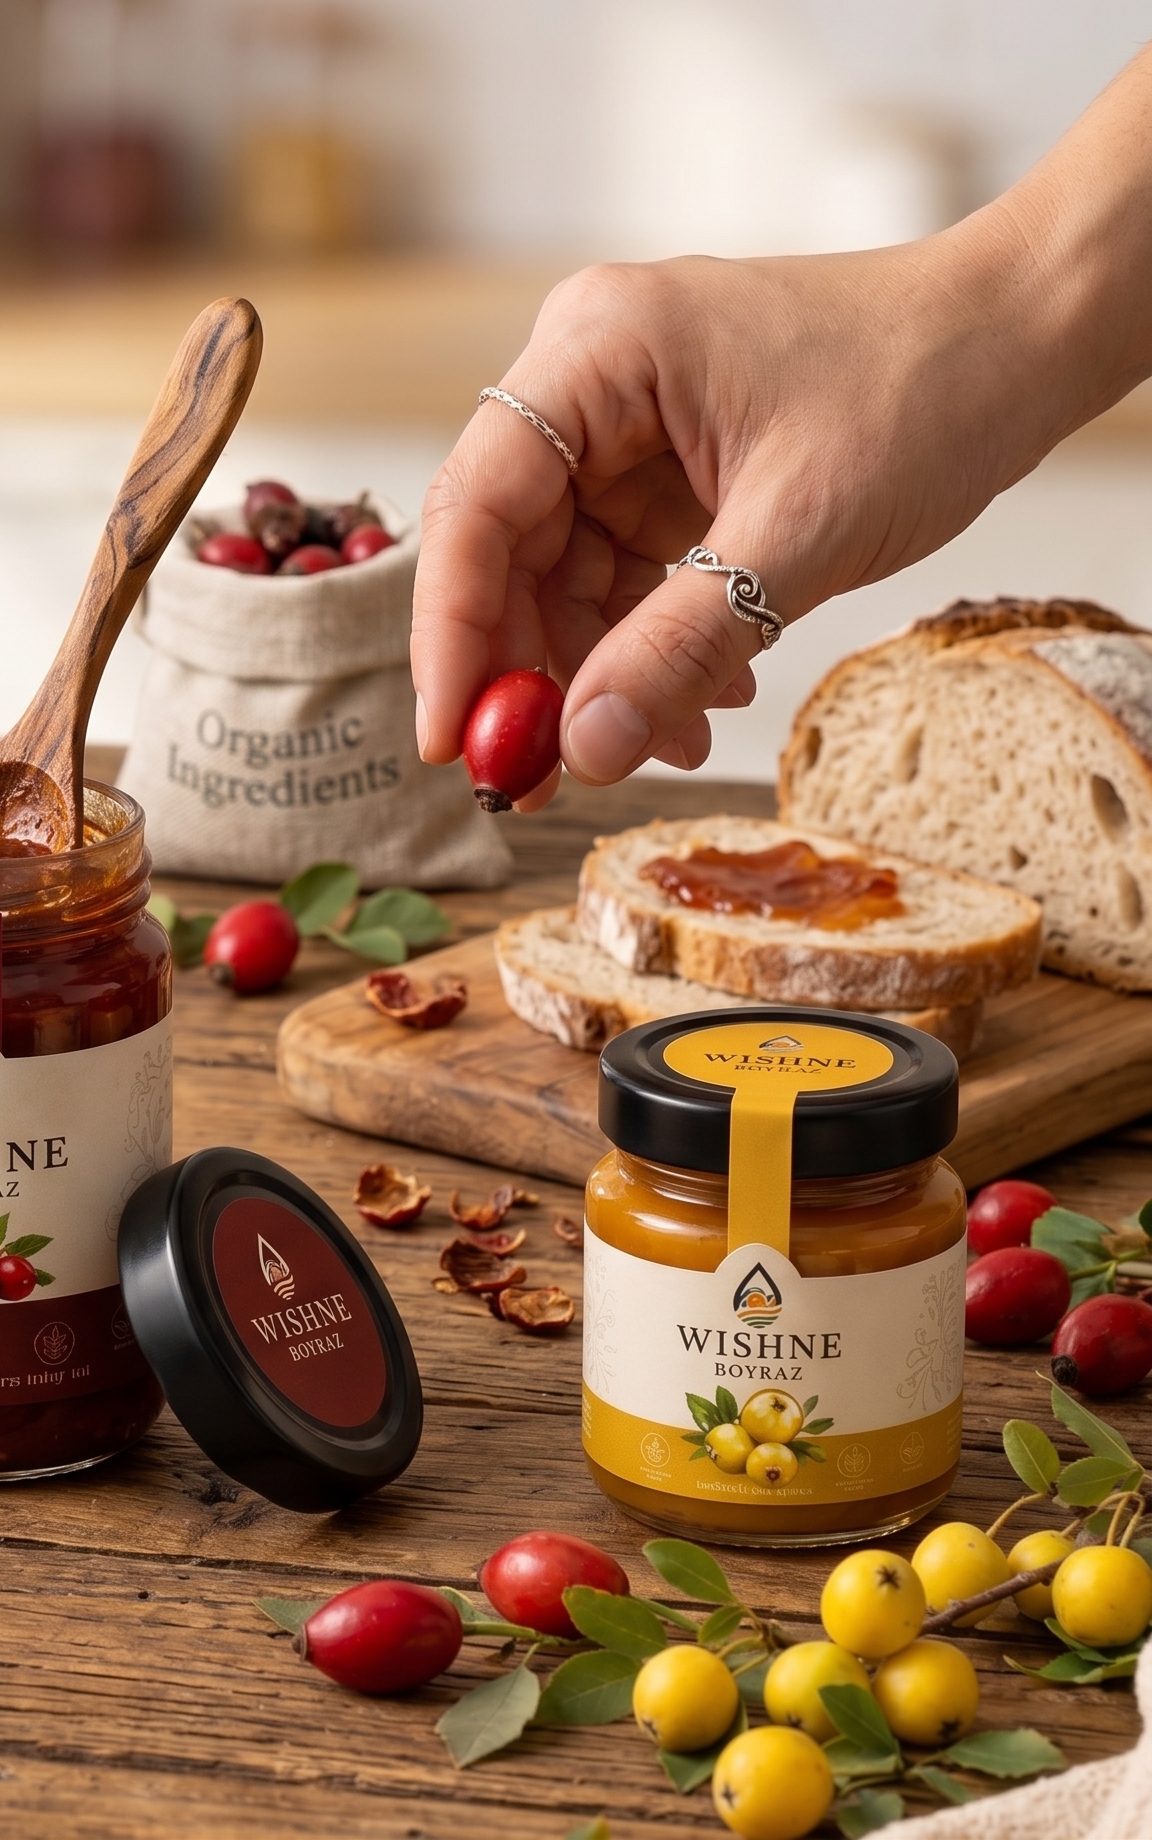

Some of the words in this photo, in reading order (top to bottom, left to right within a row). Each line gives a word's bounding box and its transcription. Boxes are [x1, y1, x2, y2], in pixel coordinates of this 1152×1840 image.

[197, 709, 364, 770] Organic
[167, 743, 402, 809] Ingredients
[704, 1053, 856, 1069] WISHNE
[251, 1293, 352, 1344] WISHNE
[288, 1333, 345, 1362] BOYRAZ
[676, 1324, 842, 1360] WISHNE
[714, 1362, 803, 1381] BOYRAZ
